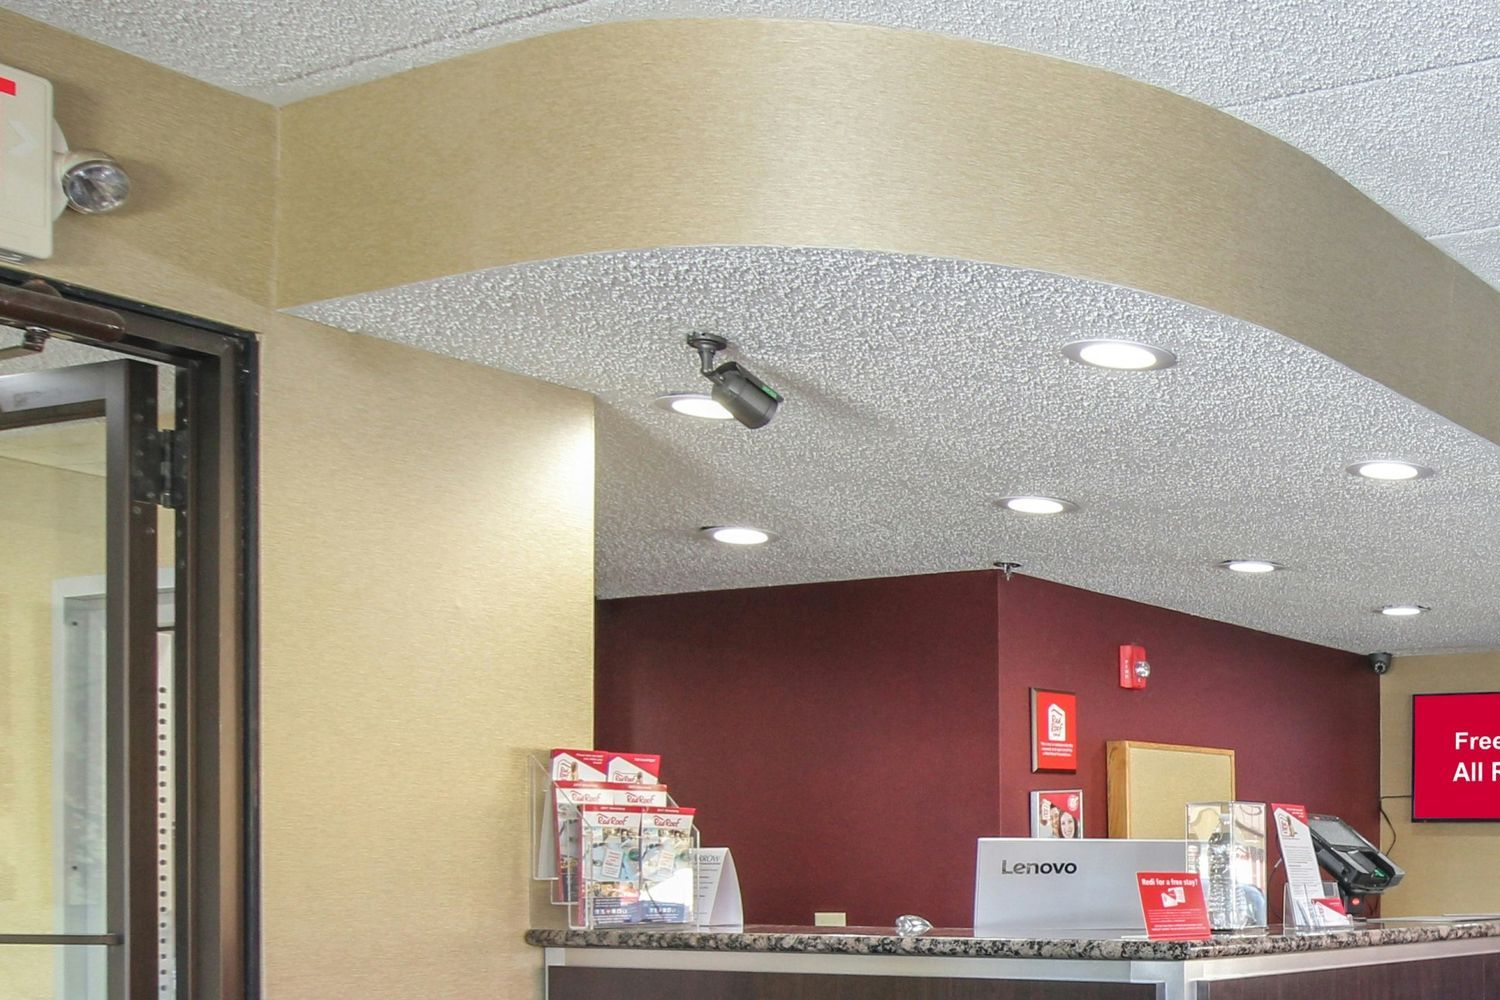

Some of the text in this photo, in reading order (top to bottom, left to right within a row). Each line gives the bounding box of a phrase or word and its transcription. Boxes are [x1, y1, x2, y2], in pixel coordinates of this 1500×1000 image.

[1452, 761, 1483, 782] All
[1001, 859, 1078, 875] Lenovo
[1171, 878, 1183, 886] free
